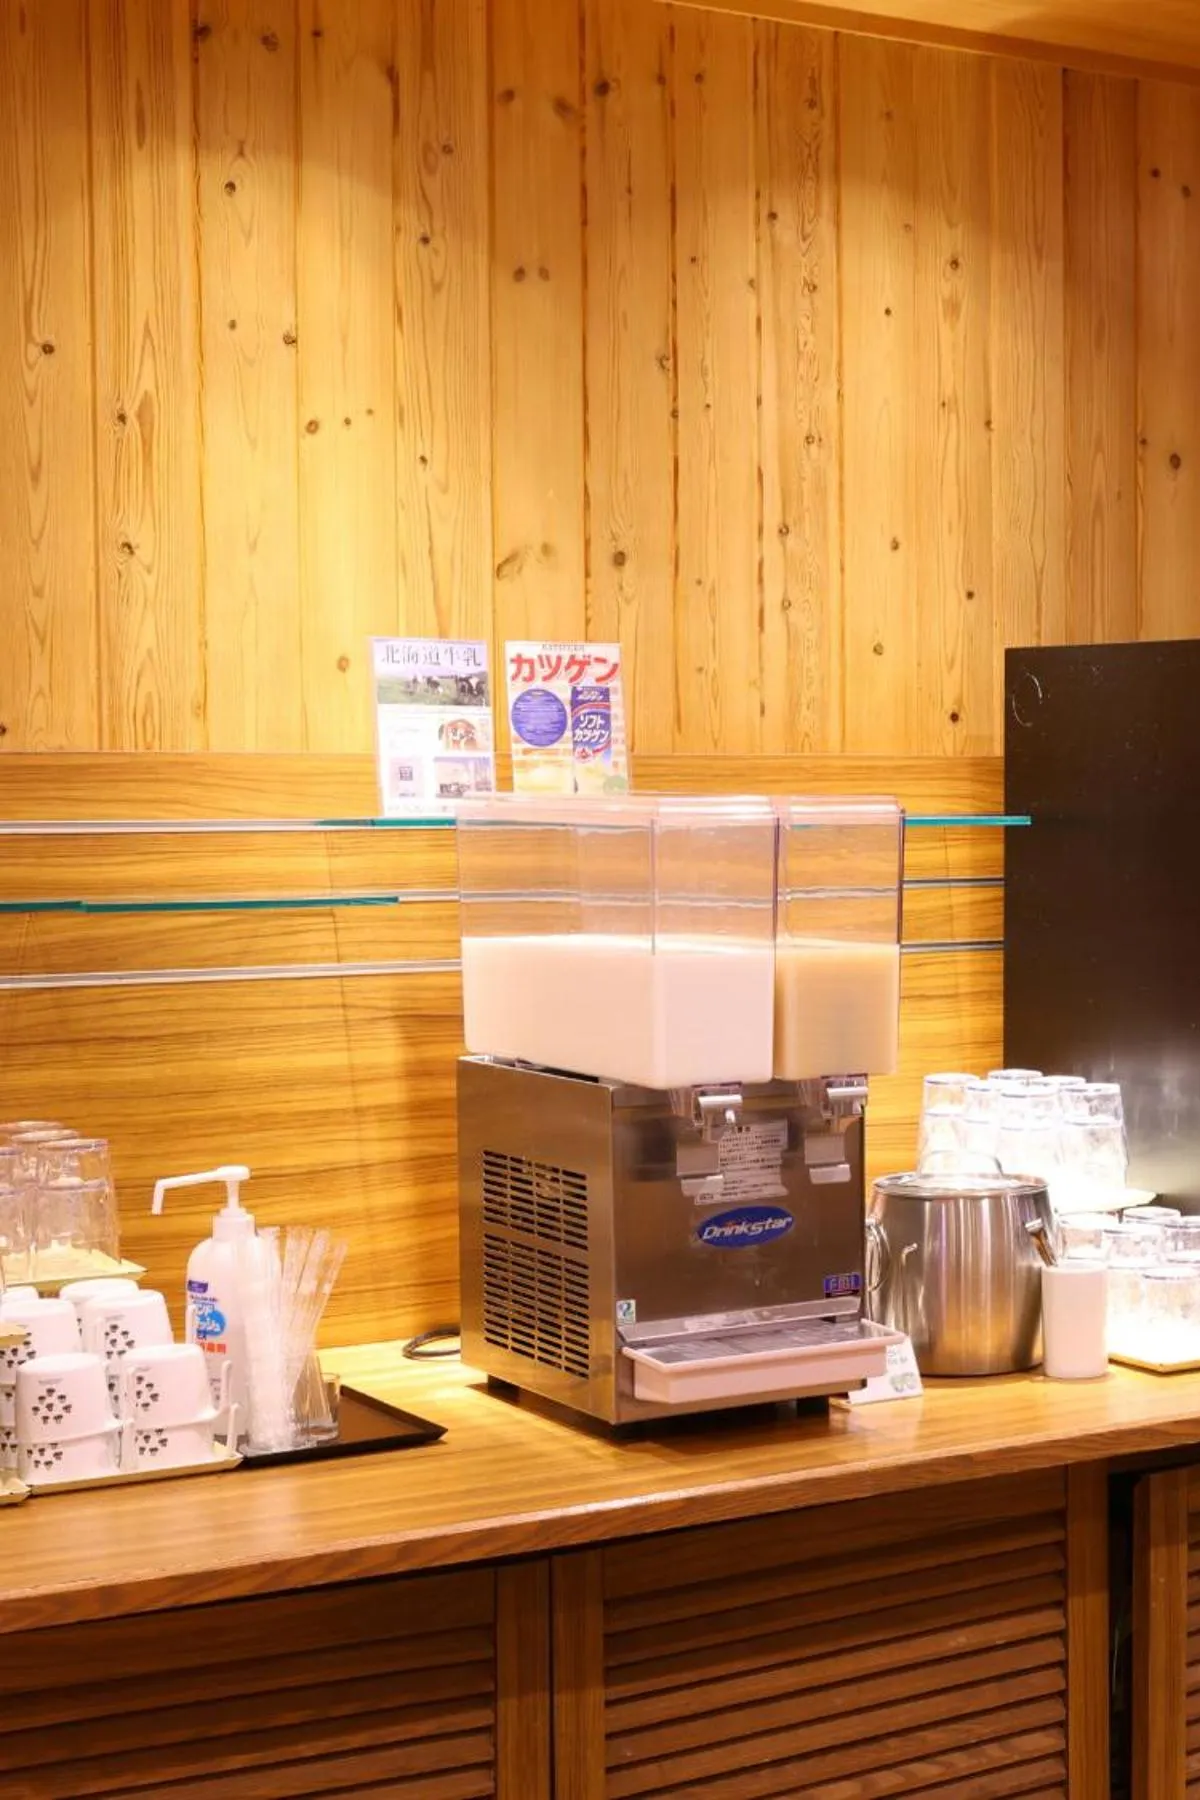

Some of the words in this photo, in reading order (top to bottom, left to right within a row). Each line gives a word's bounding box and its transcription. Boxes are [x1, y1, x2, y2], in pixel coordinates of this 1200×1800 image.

[381, 644, 482, 667] 北海道牛乳
[510, 653, 619, 683] カツゲン
